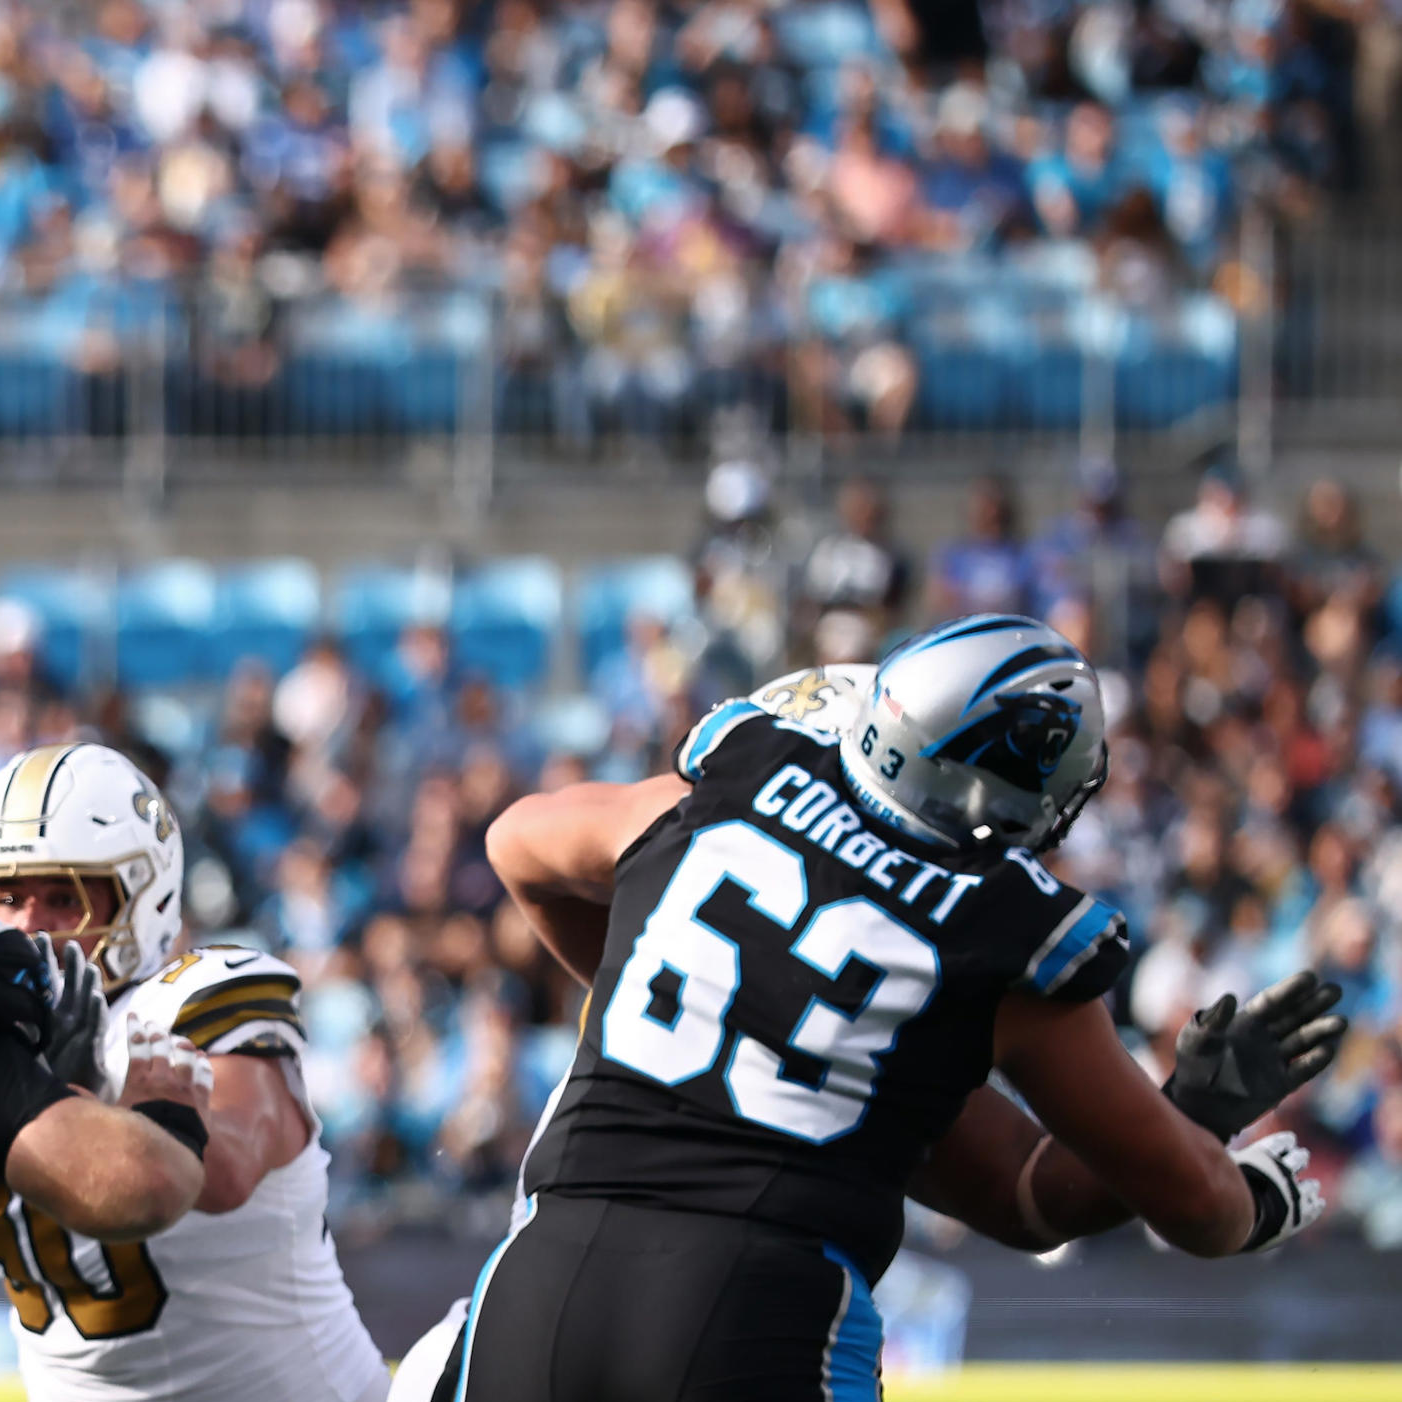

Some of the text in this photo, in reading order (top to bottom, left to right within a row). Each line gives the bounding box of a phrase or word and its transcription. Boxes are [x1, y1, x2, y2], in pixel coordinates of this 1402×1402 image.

[860, 723, 906, 781] 63
[752, 762, 985, 926] CORBETT
[600, 818, 944, 1146] 63
